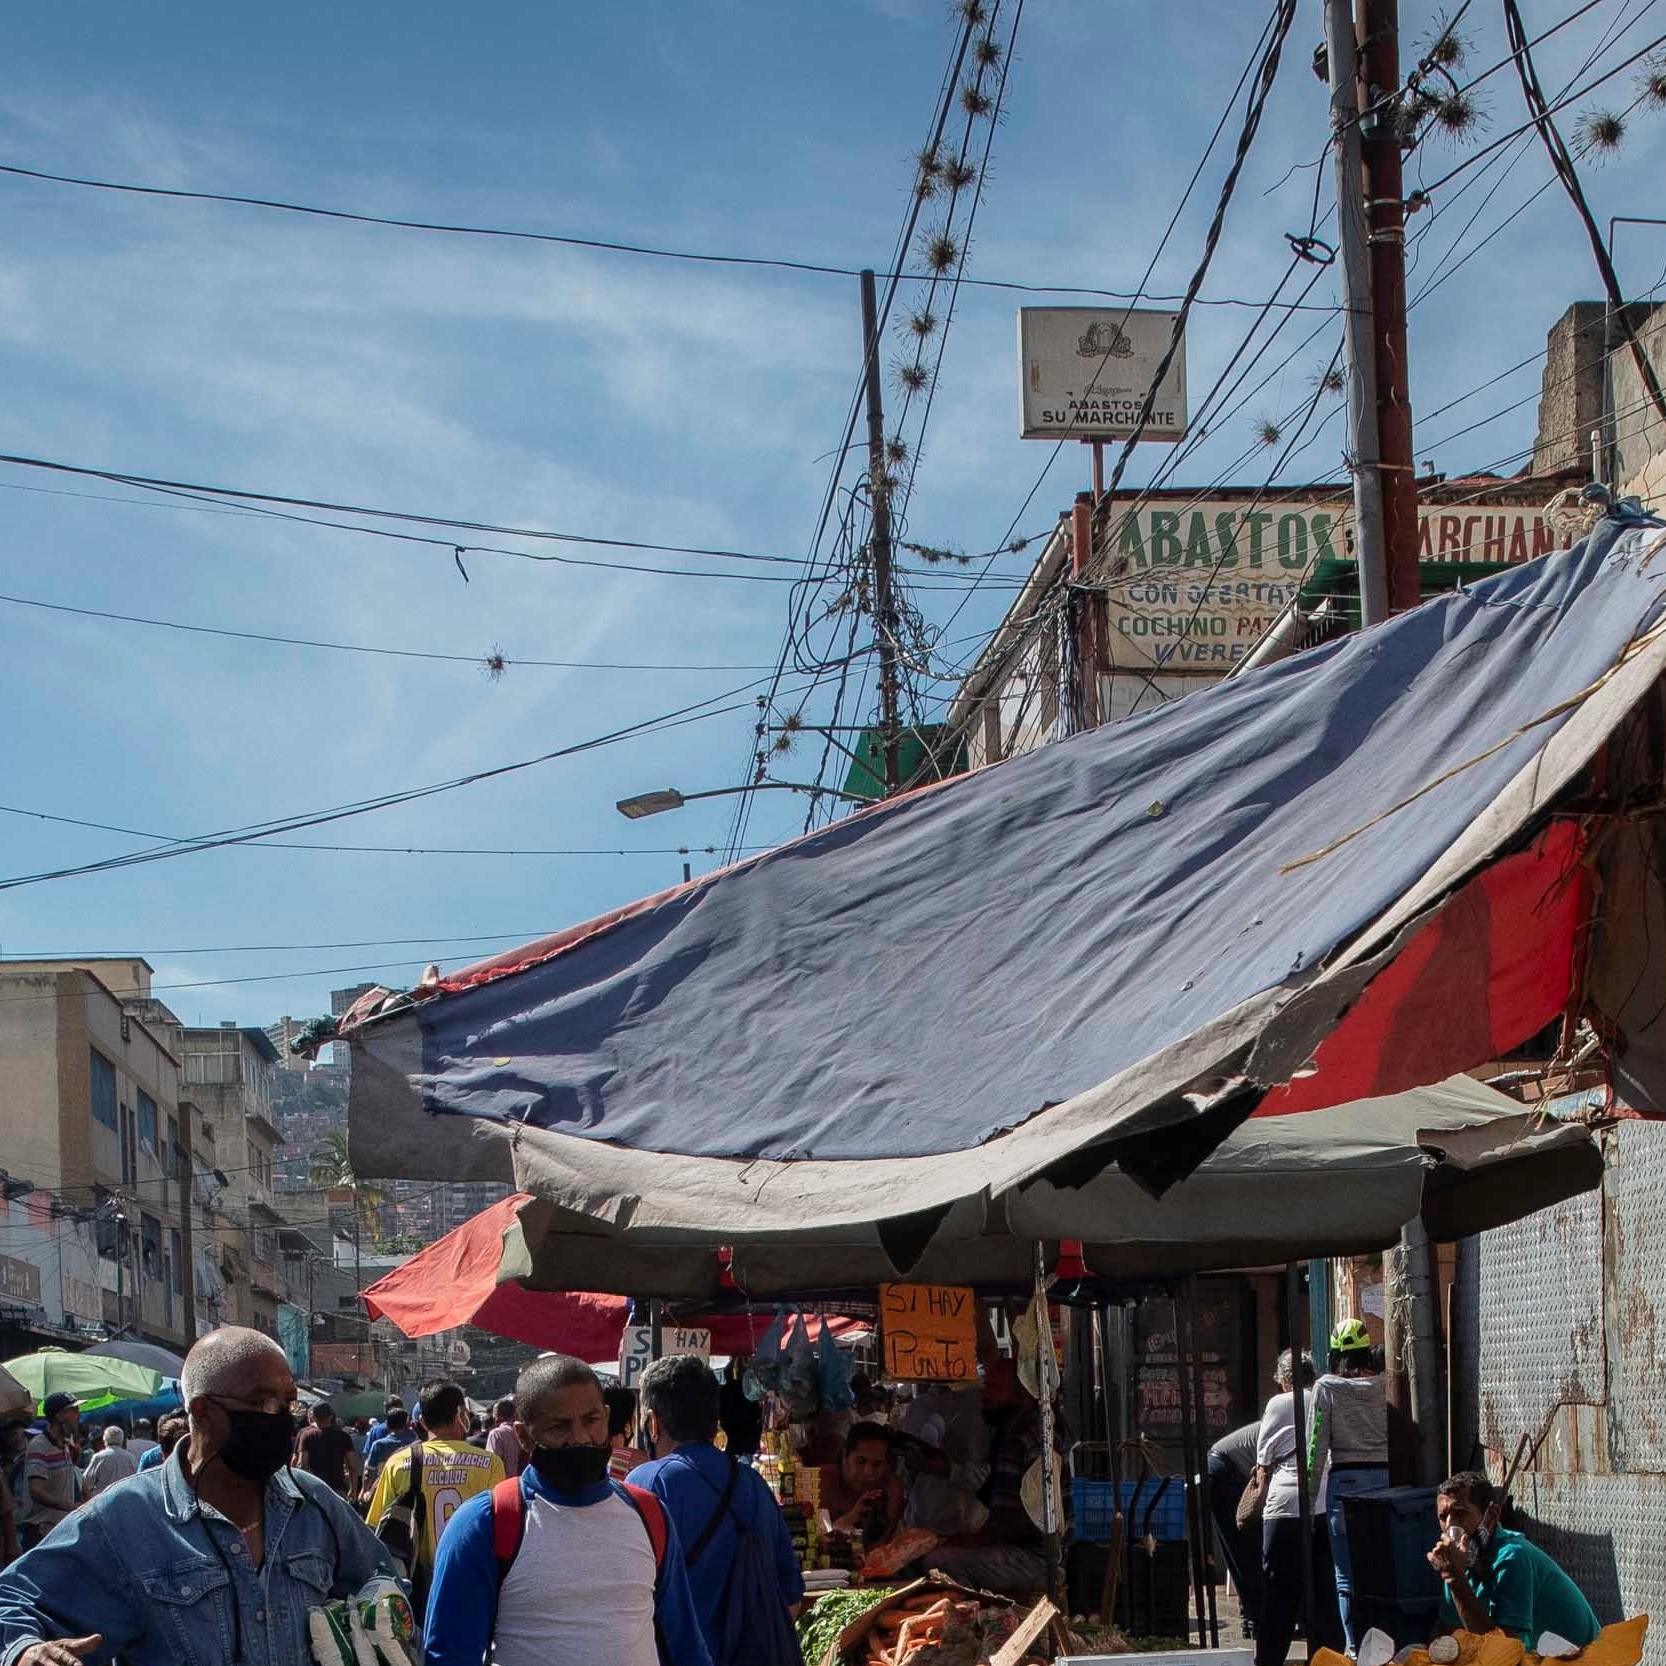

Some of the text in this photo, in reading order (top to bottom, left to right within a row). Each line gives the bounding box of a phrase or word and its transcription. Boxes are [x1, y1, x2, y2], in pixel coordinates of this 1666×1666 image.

[1068, 400, 1142, 411] ABASTOS
[1043, 410, 1066, 423] SU
[1117, 511, 1336, 569] ABASTOS
[1128, 583, 1177, 604] CON
[1117, 616, 1226, 636] COCHINO
[1154, 643, 1254, 662] VIVERE
[886, 1283, 965, 1317] SI HAY
[633, 1330, 710, 1355] S HAY
[442, 1453, 490, 1469] CAMACHO
